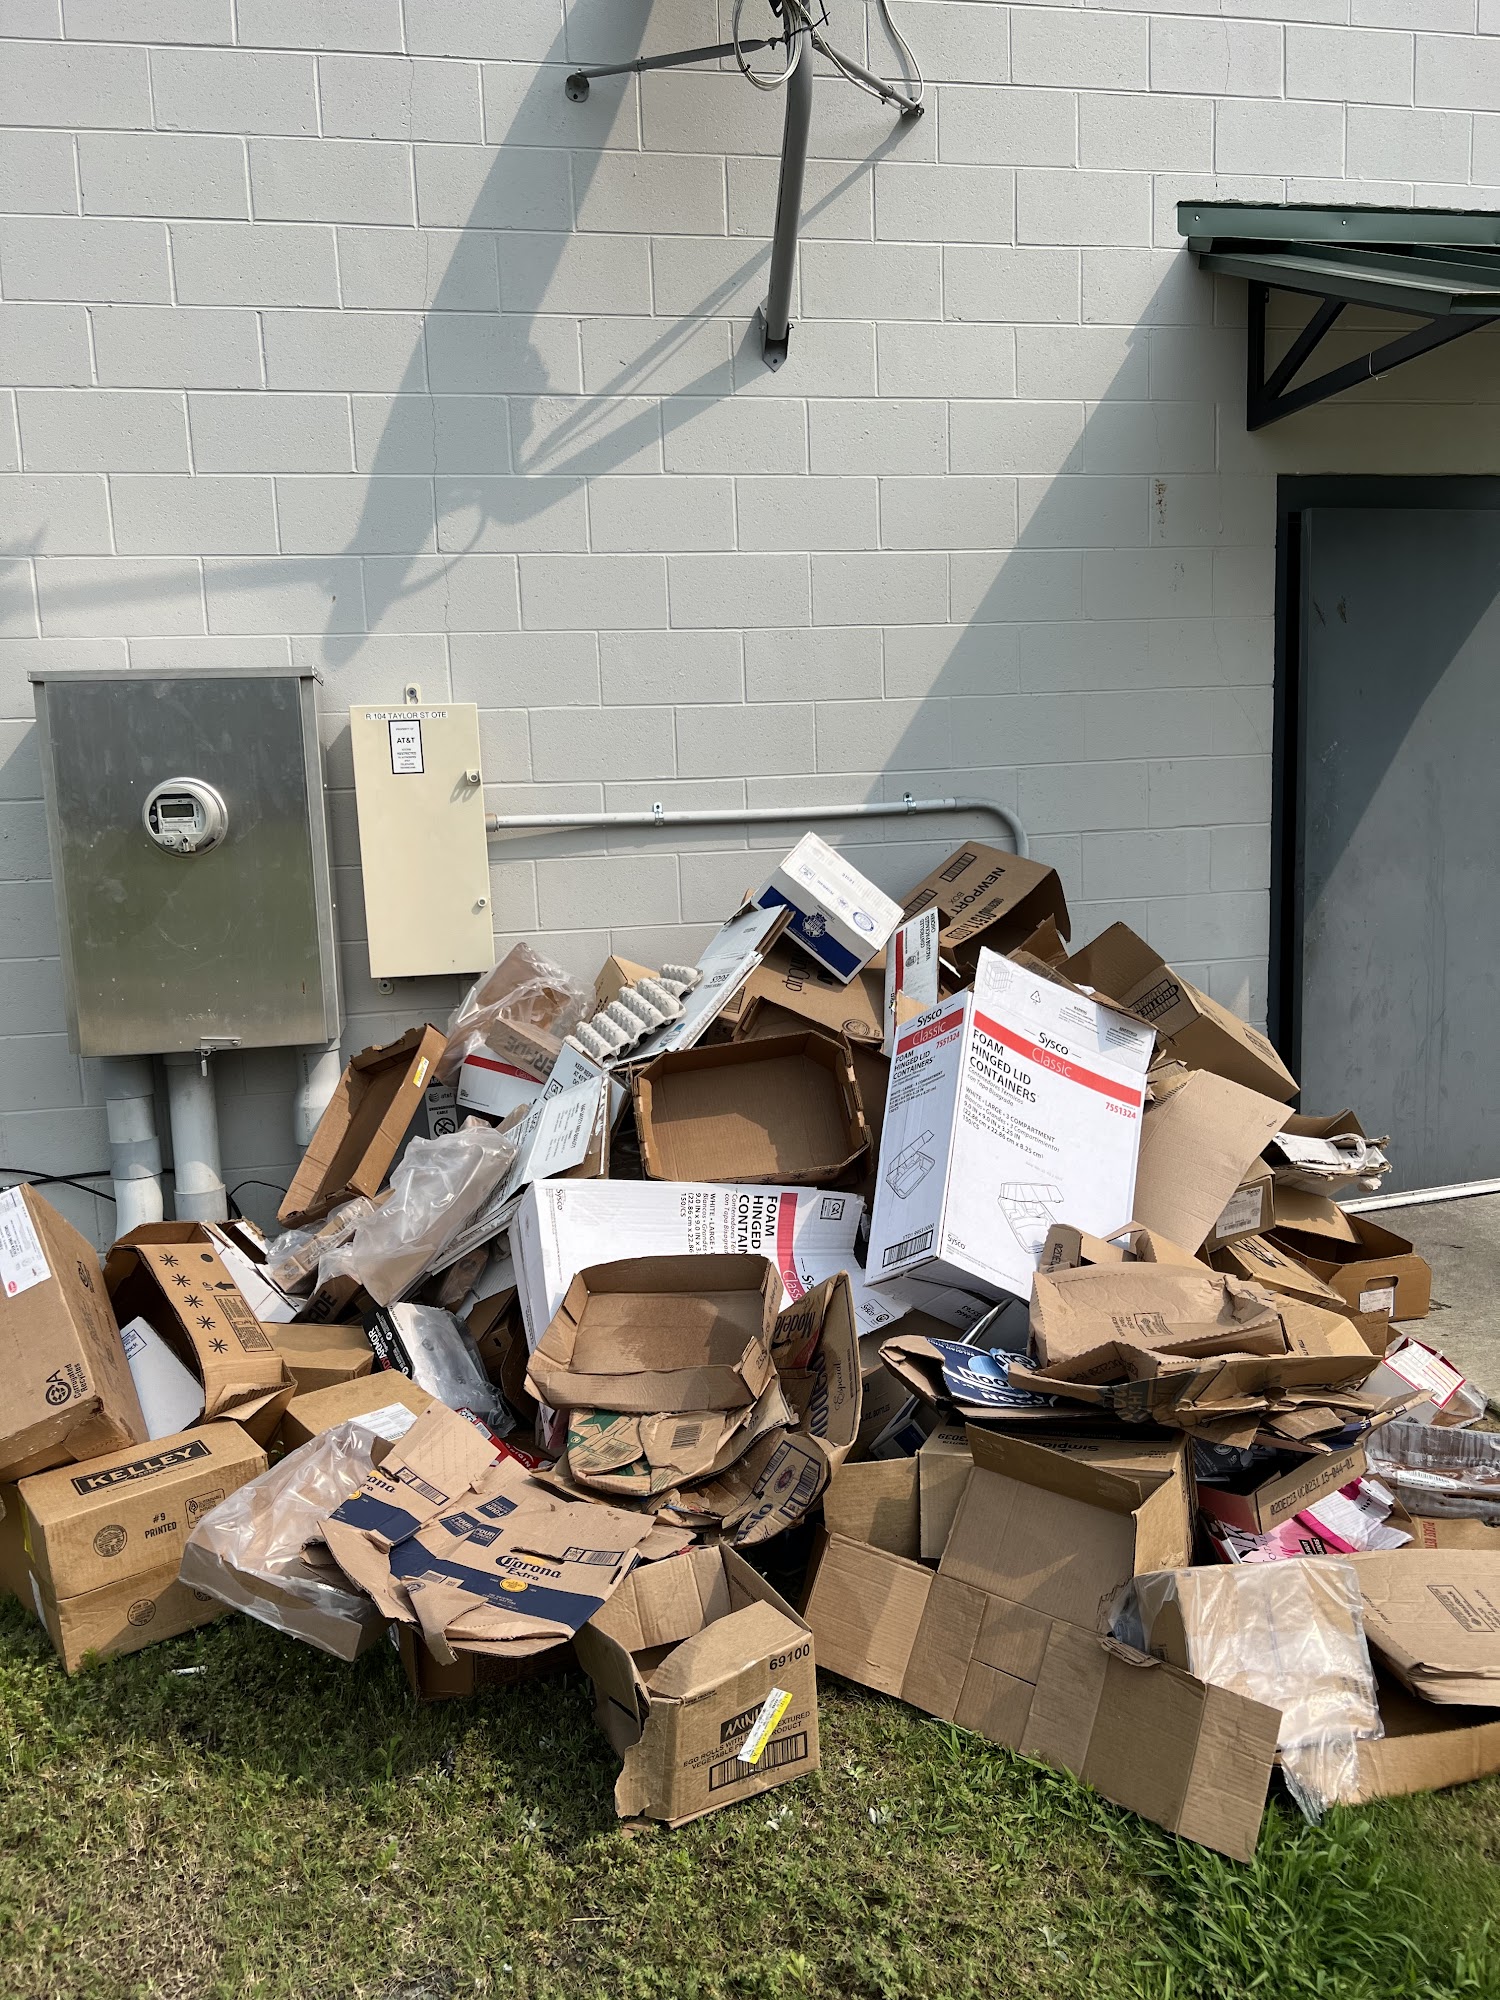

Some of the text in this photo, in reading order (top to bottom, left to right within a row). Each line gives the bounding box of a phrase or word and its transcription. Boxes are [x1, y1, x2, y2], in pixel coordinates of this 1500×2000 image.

[388, 712, 418, 720] TAYLOR
[950, 866, 1006, 916] NEWPORT
[950, 890, 965, 904] BOX
[916, 1008, 943, 1028] Sysco
[912, 1021, 947, 1046] Classic
[936, 1030, 960, 1050] 7551324
[972, 1028, 1004, 1057] FOAM
[1037, 1031, 1069, 1056] Sysco
[893, 1058, 934, 1080] CONTAINERS
[894, 1050, 931, 1072] HINGED LID
[895, 1050, 915, 1064] FOAM
[971, 1042, 1032, 1086] HINGED LID
[1031, 1047, 1073, 1078] Classic
[968, 1066, 1024, 1105] Contenedores Térmicos
[969, 1056, 1037, 1104] CONTAINERS
[964, 1094, 983, 1110] Blancos
[986, 1106, 1007, 1125] Grandes
[964, 1100, 973, 1110] 9.0
[982, 1110, 991, 1121] 9.0
[1001, 1126, 1014, 1138] 3.25
[966, 1087, 982, 1100] WHITE
[984, 1098, 1003, 1115] LARGE
[1010, 1114, 1056, 1143] COMPARTMENT
[1105, 1102, 1137, 1120] 7551324
[962, 1115, 980, 1130] 150/CS
[962, 1108, 978, 1121] (22.86
[991, 1126, 1006, 1141] 22.86
[1020, 1143, 1032, 1154] 8.25
[688, 1216, 692, 1227] cm
[696, 1206, 700, 1214] IN
[731, 1194, 739, 1238] Contenedores
[750, 1194, 764, 1250] HINGED
[764, 1195, 778, 1238] FOAM
[696, 1232, 700, 1241] IN
[738, 1194, 750, 1255] CONTAIN
[947, 1233, 966, 1250] Sysco
[202, 1281, 214, 1292] UP
[782, 1270, 806, 1303] Class
[802, 1274, 814, 1291] Sys
[368, 1328, 393, 1372] DYARMOR
[64, 1363, 82, 1400] Corrugated
[73, 1362, 89, 1393] Recycles
[832, 1362, 846, 1411] Especial
[957, 1365, 1010, 1390] OON
[1036, 1442, 1100, 1453] Simplo
[86, 1447, 194, 1490] KELLEY
[484, 1504, 504, 1517] FOUR
[1270, 1492, 1298, 1516] 02DEC23
[144, 1521, 178, 1540] PRINTED
[455, 1516, 474, 1530] FOUR
[476, 1527, 496, 1538] FOUR
[737, 1503, 774, 1541] delo
[495, 1555, 562, 1579] Corona
[506, 1568, 540, 1582] Extra
[769, 1644, 810, 1671] 69100
[725, 1706, 764, 1738] MIN
[683, 1710, 811, 1768] EGG ROLLS WITH EXTURED
[691, 1720, 802, 1770] VEGETABLE RODUCT
